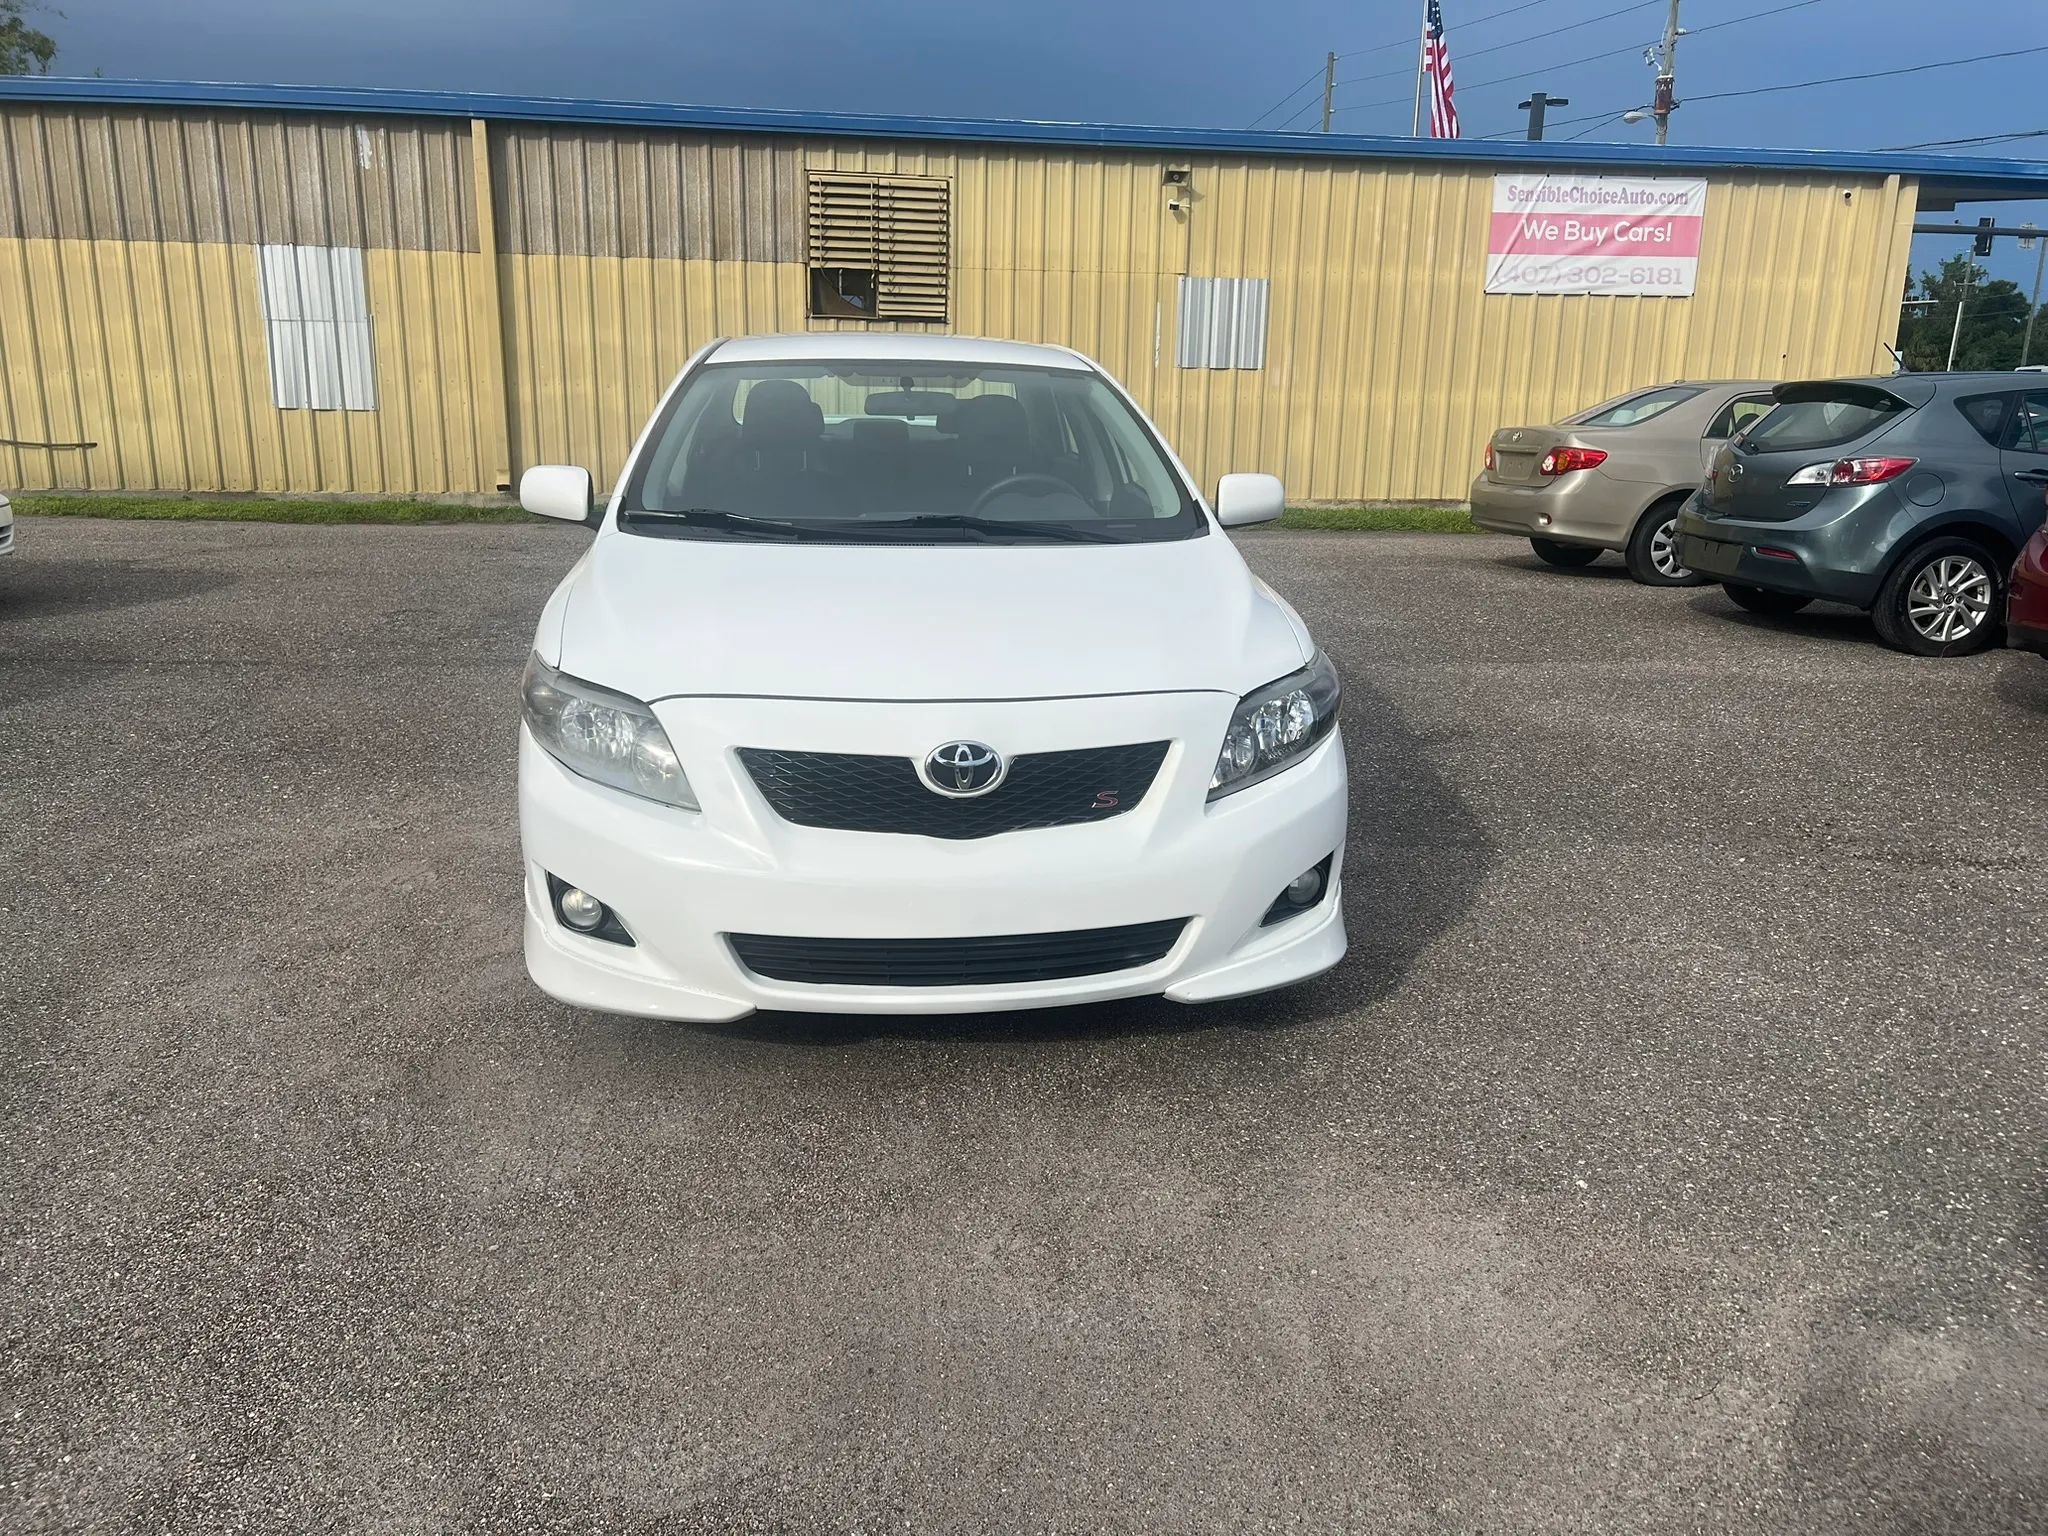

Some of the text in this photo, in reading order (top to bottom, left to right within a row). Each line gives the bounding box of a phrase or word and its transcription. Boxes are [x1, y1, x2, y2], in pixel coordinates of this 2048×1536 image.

[1522, 219, 1673, 247] We Buy Cars!
[1567, 265, 1683, 286] 302-6181
[1091, 790, 1119, 809] S
